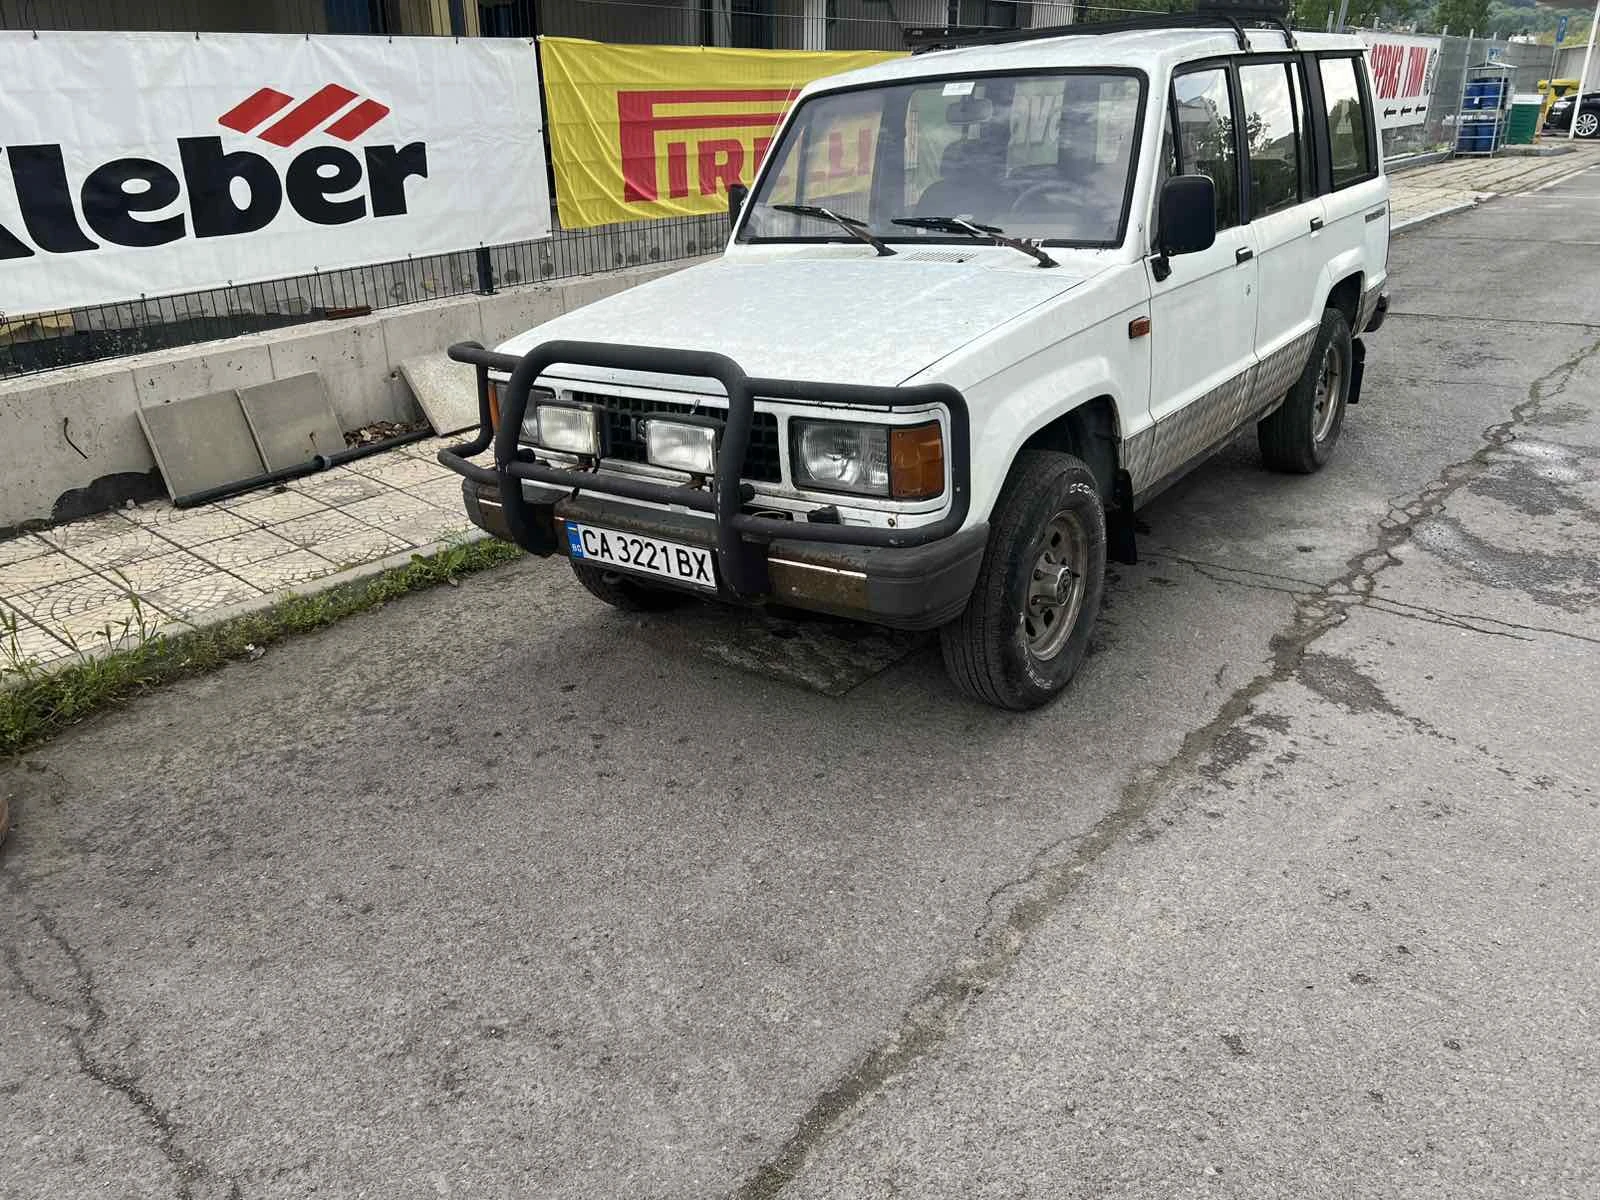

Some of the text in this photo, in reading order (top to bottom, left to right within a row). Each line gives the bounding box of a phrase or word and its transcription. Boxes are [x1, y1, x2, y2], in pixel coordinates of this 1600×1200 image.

[0, 136, 428, 259] leber
[617, 89, 871, 203] PIRLI
[582, 529, 710, 582] CA 3221 BX
